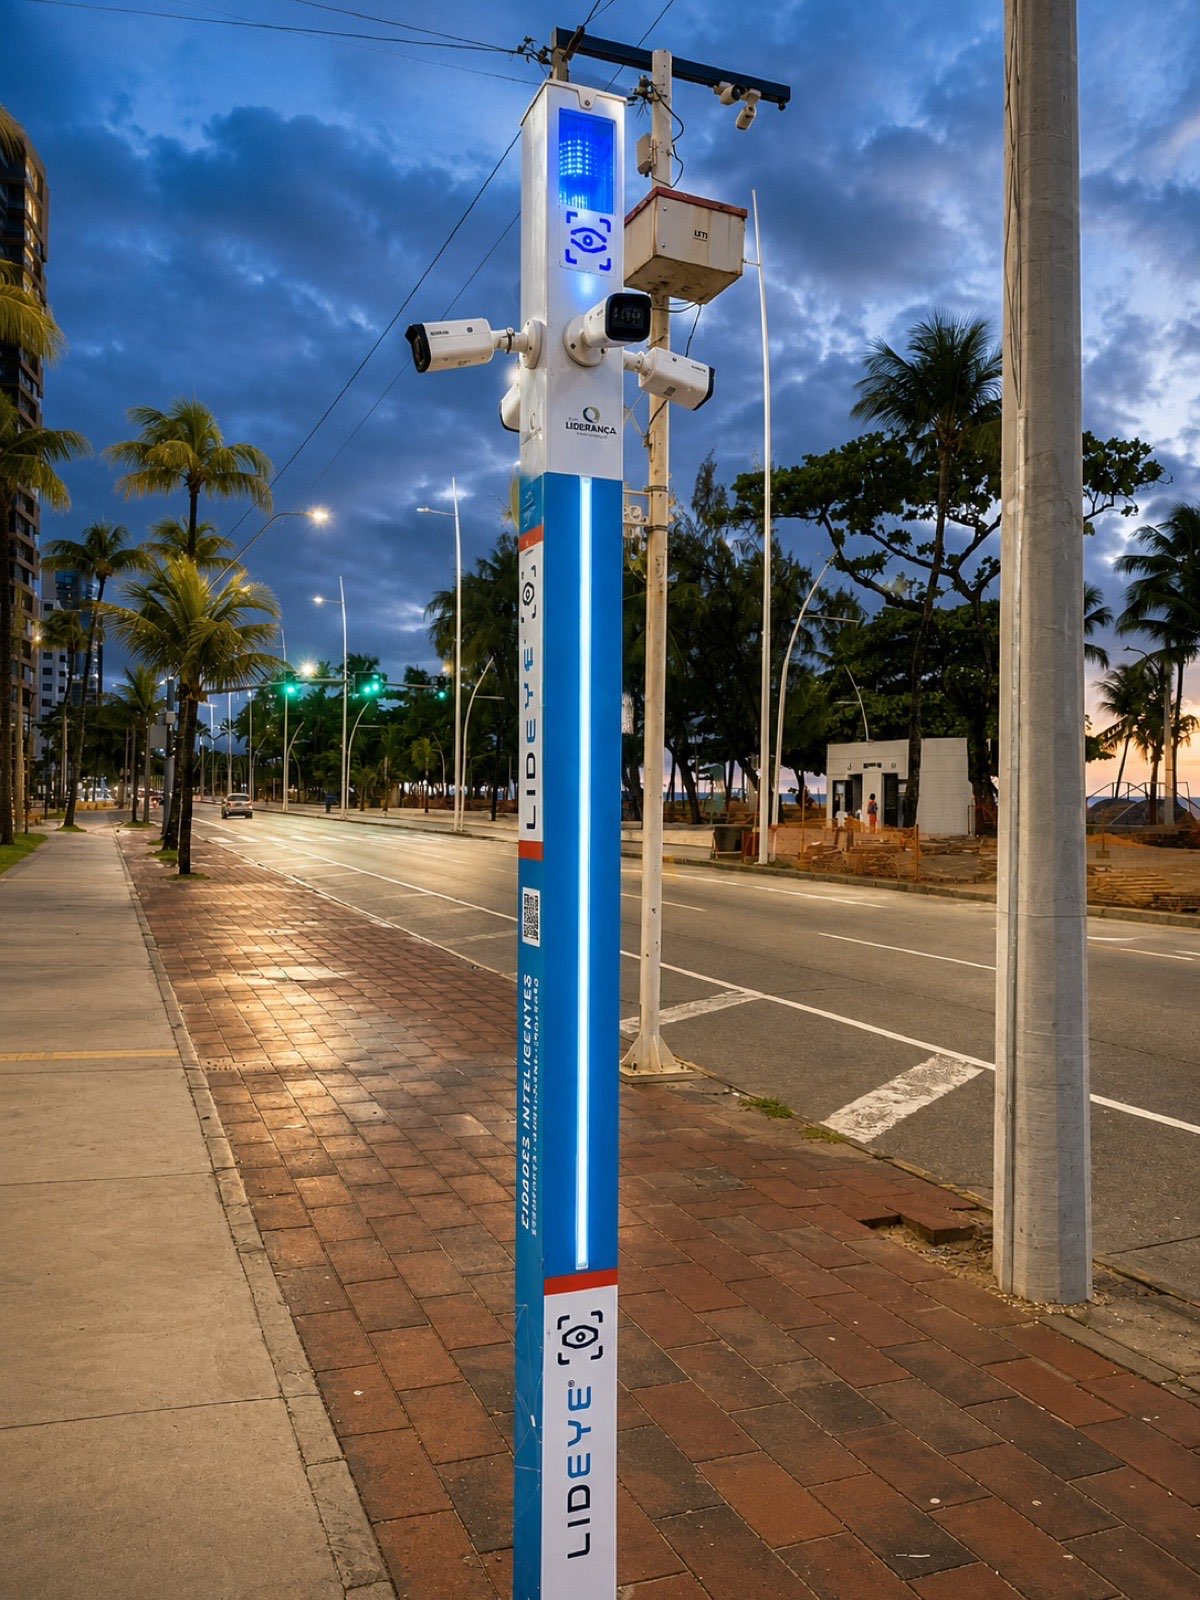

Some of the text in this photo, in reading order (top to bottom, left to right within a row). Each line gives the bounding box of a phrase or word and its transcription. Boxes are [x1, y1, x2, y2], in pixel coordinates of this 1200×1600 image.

[565, 421, 617, 435] LIDERANÇA
[523, 647, 536, 829] LIDEYE
[521, 1136, 530, 1230] CIDADES
